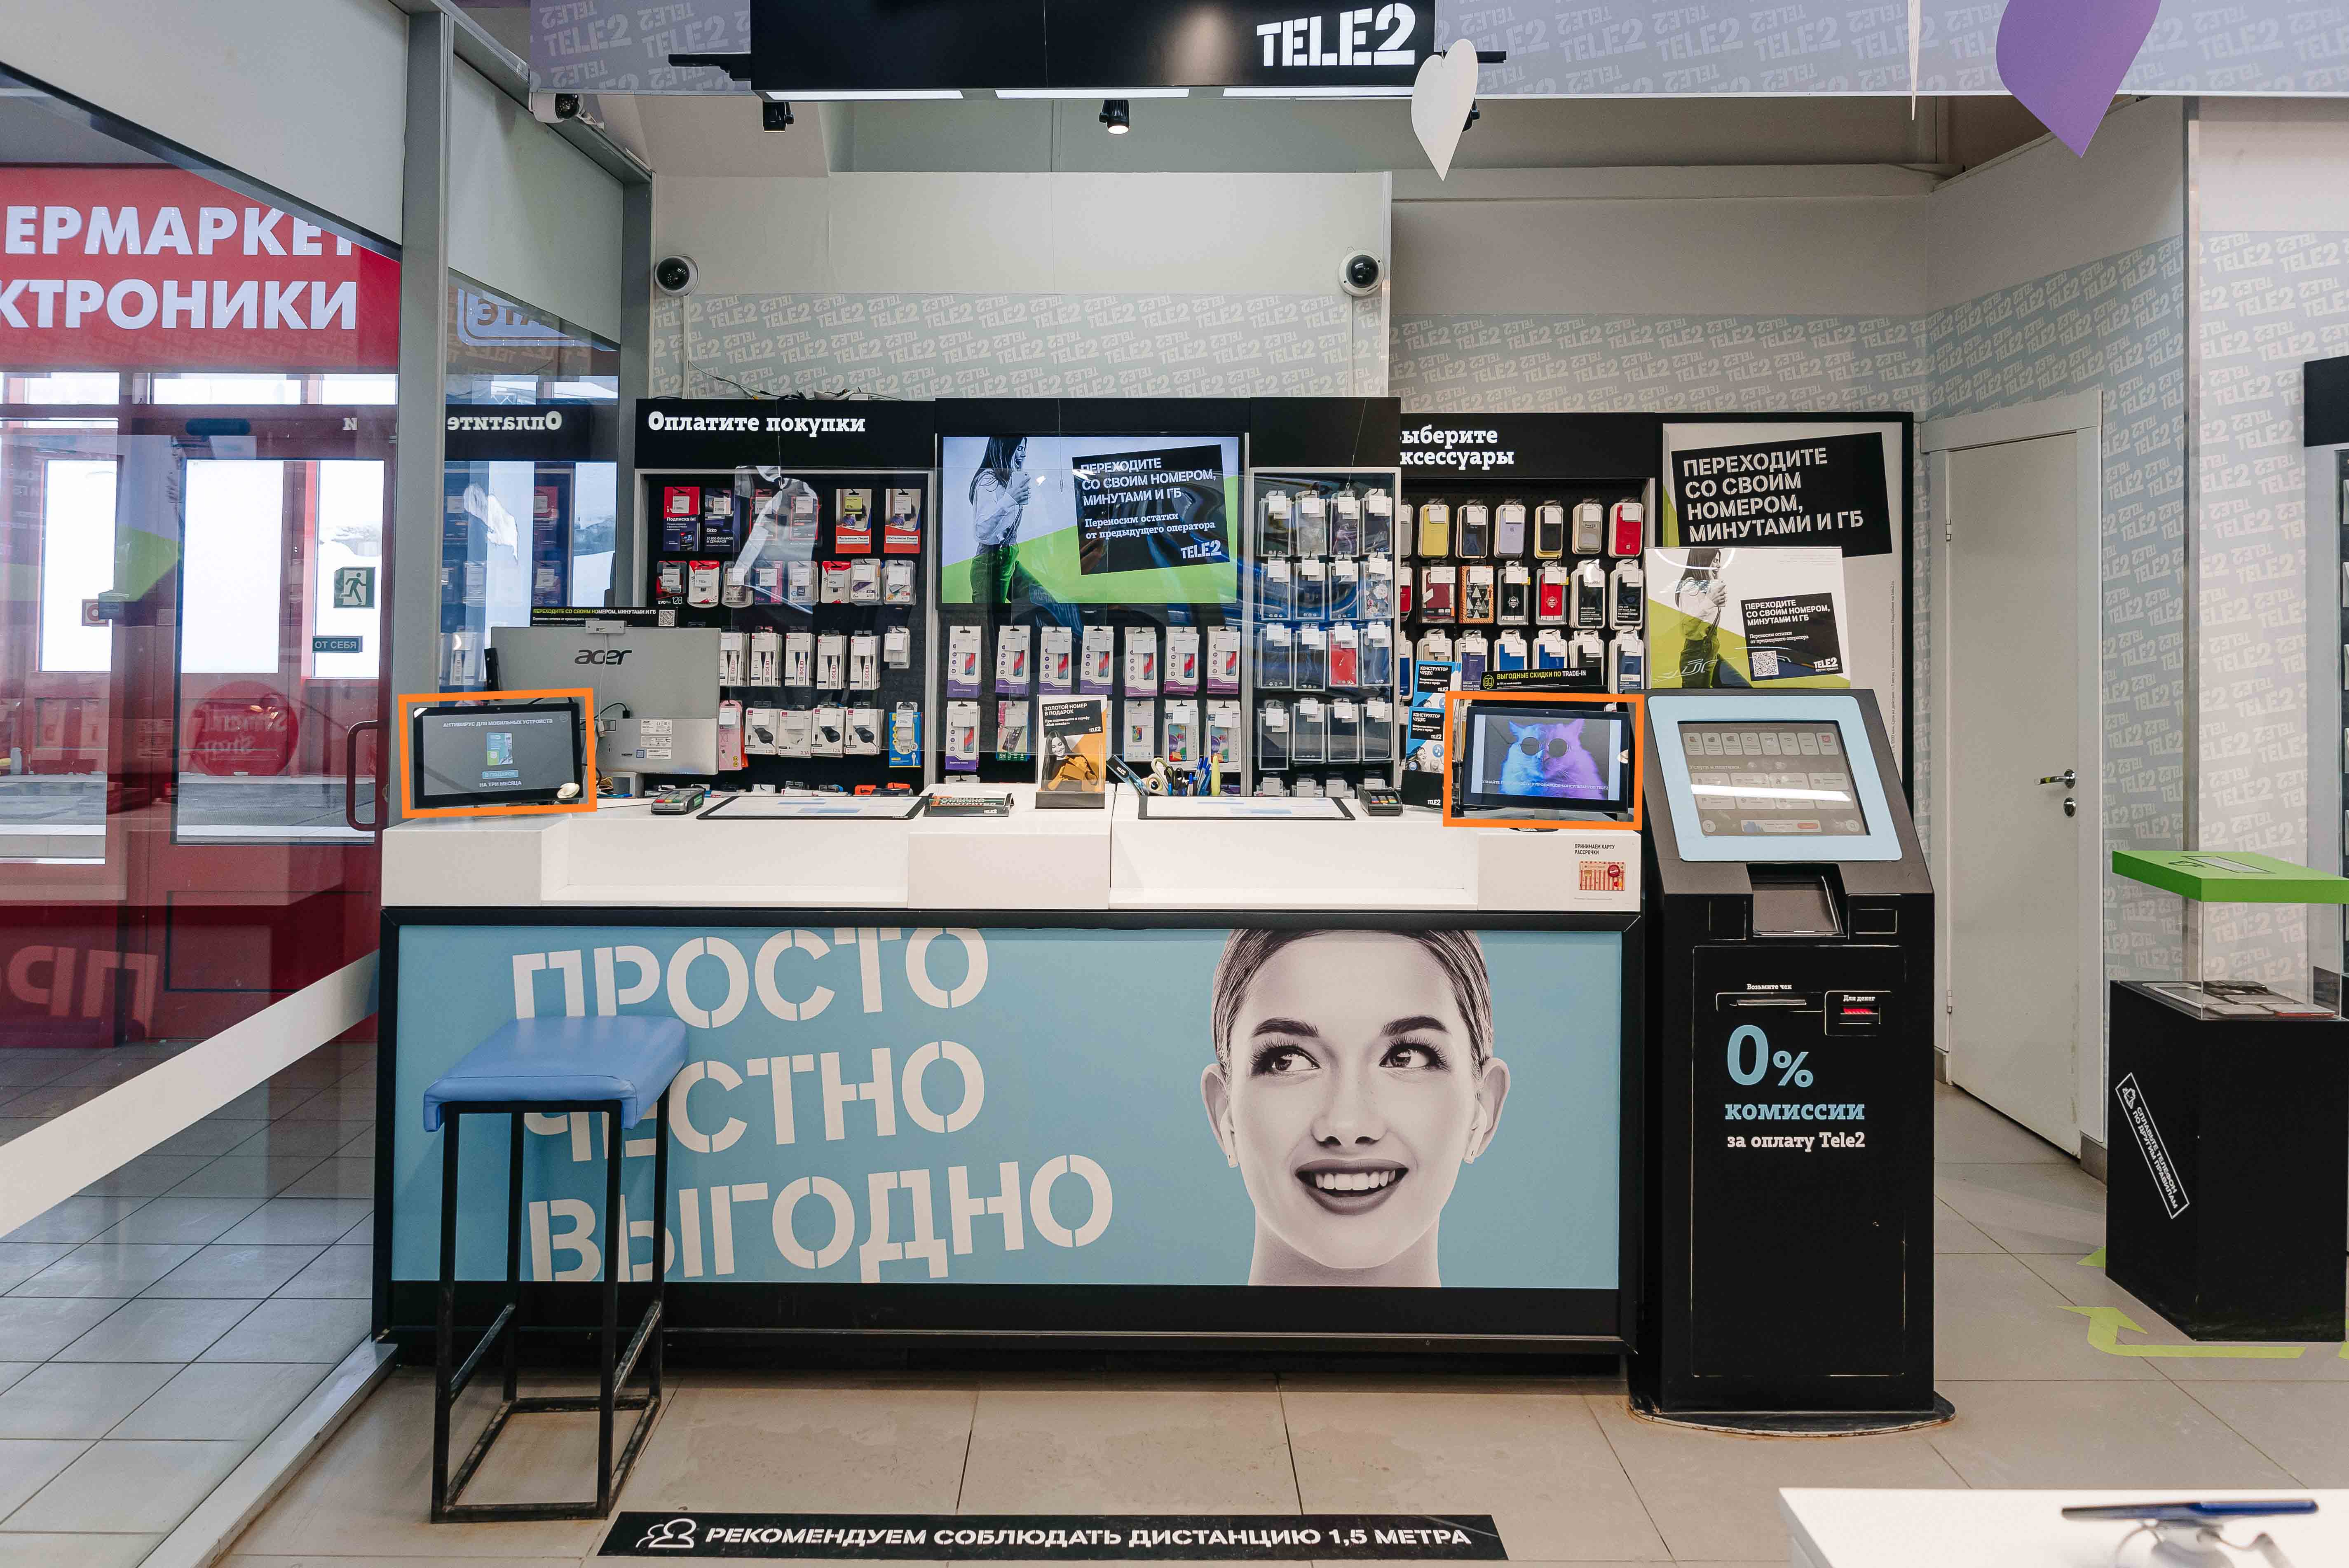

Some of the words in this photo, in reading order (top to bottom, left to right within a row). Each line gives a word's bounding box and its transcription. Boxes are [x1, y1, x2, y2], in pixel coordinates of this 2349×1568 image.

[544, 14, 632, 56] TELE2
[642, 16, 729, 58] TELE2
[1257, 3, 1416, 66] TELE2
[1560, 18, 1647, 62] TELE2
[1656, 17, 1743, 61] TELE2
[1753, 17, 1841, 61] TELE2
[2208, 232, 2250, 253] TELE2
[2214, 242, 2274, 273] TELE2
[2280, 242, 2340, 273] TELE2
[2236, 286, 2295, 316] TELE2
[711, 303, 756, 328] TELE2
[818, 303, 865, 328] TELE2
[980, 302, 1027, 330] TELE2
[1088, 302, 1137, 329] TELE2
[726, 339, 773, 364] TELE2
[943, 339, 991, 364] TELE2
[648, 411, 759, 431] Оплатите
[767, 416, 865, 437] покупки
[1400, 424, 1498, 449] ыберите
[1081, 457, 1161, 474] ПЕРЕХОДИТЕ
[1400, 452, 1514, 470] ксессуары
[1683, 448, 1827, 477] ПЕРЕХОДИТЕ
[1082, 479, 1100, 490] СО
[1103, 475, 1148, 488] СВОИМ
[1151, 469, 1216, 484] НОМЕРОМ,
[1685, 480, 1716, 498] СО
[1723, 472, 1801, 494] СВОИМ
[1083, 490, 1152, 506] МИНУТАМИ
[1155, 489, 1163, 500] И
[1166, 487, 1182, 499] ГБ
[1688, 495, 1803, 521] НОМЕРОМ,
[1085, 517, 1138, 528] Переносим
[1141, 513, 1179, 523] остатки
[1099, 526, 1164, 540] предыдущего
[1167, 521, 1216, 534] оператора
[1689, 515, 1811, 542] МИНУТАМИ
[1817, 513, 1832, 530] И
[1837, 510, 1863, 529] ГБ
[1181, 540, 1221, 560] TELE2
[1745, 600, 1796, 610] ПЕРЕХОДИТЕ
[1759, 608, 1788, 616] СВОИМ
[1789, 605, 1830, 614] НОМЕРОМ,
[1747, 616, 1791, 626] МИНУТАМИ
[314, 641, 328, 649] ОТ
[331, 641, 357, 650] СЕБЯ
[574, 649, 633, 665] acer
[1814, 657, 1838, 668] TELE2
[1497, 672, 1528, 680] ВЫГОДНЫЕ
[1116, 766, 1127, 775] TELE2
[512, 927, 989, 1029] ПРОСТО
[1727, 1024, 1814, 1087] 0%
[1725, 1104, 1865, 1120] комиссии
[1727, 1136, 1746, 1148] за
[1751, 1136, 1814, 1152] оплату
[1819, 1132, 1865, 1148] Tele2
[2133, 1111, 2140, 1124] ПО
[2138, 1125, 2157, 1160] ДРУГИМ
[2154, 1160, 2178, 1209] ПРАВИЛАМ
[2157, 1151, 2177, 1193] ТЕЛЕФОН
[529, 1154, 1113, 1283] ВЫГОДНО
[706, 1528, 926, 1547] РЕКОМЕНДУЕМ
[934, 1529, 1121, 1547] СОБЛЮДАТЬ
[1129, 1529, 1320, 1548] ДИСТАНЦИЮ
[1329, 1529, 1367, 1546] 1,5
[1374, 1529, 1471, 1545] МЕТРА
